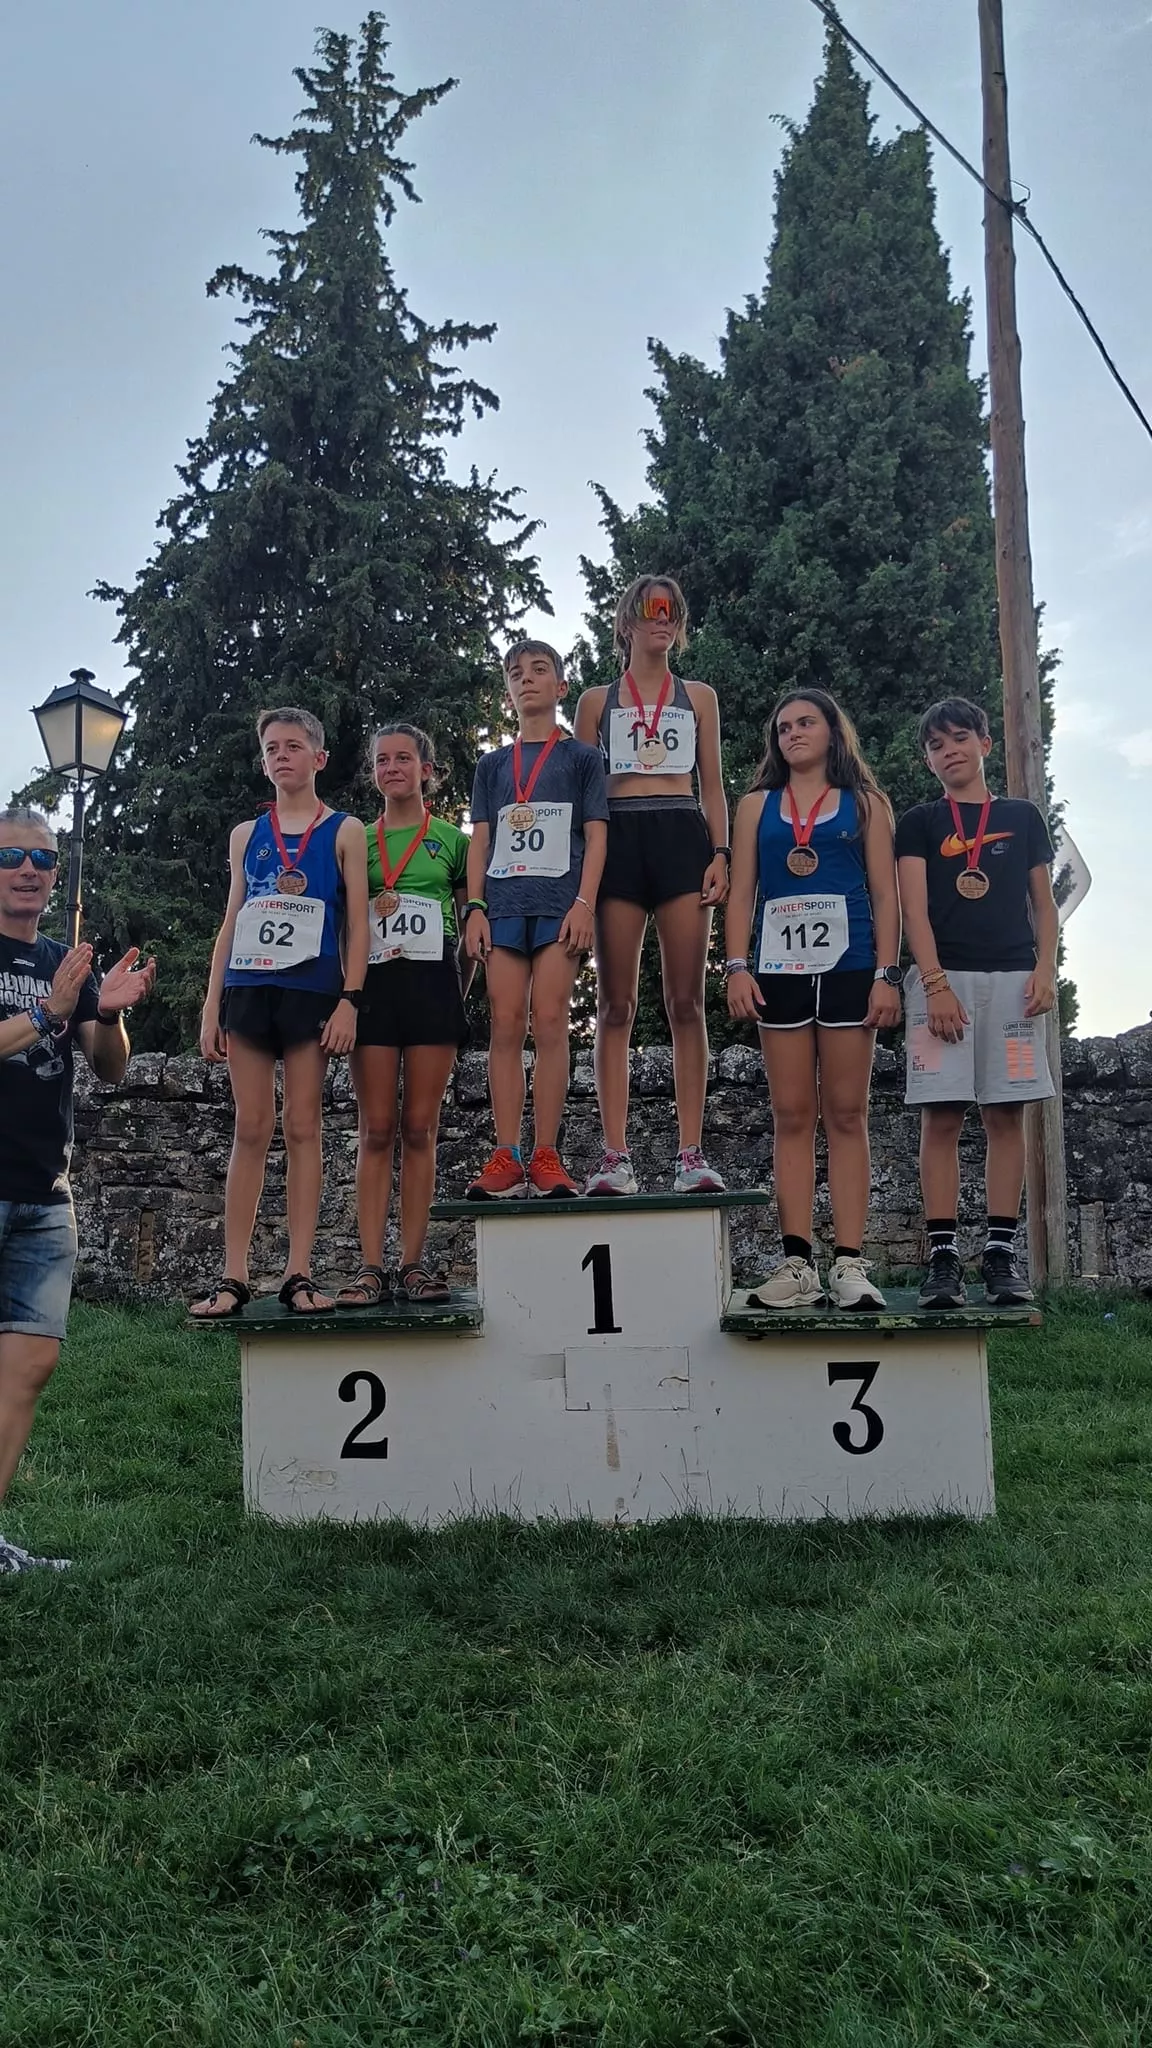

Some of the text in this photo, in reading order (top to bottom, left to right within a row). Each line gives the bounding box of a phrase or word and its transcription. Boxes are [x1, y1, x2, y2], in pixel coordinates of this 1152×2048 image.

[628, 728, 679, 751] 16
[511, 829, 545, 852] 30
[254, 900, 317, 914] INTERSPORT
[777, 901, 837, 913] INTERSPORT
[259, 920, 295, 947] 62
[377, 913, 426, 939] 140
[781, 922, 830, 950] 112
[580, 1244, 623, 1335] 1
[337, 1370, 389, 1460] 2
[826, 1360, 885, 1456] 3
